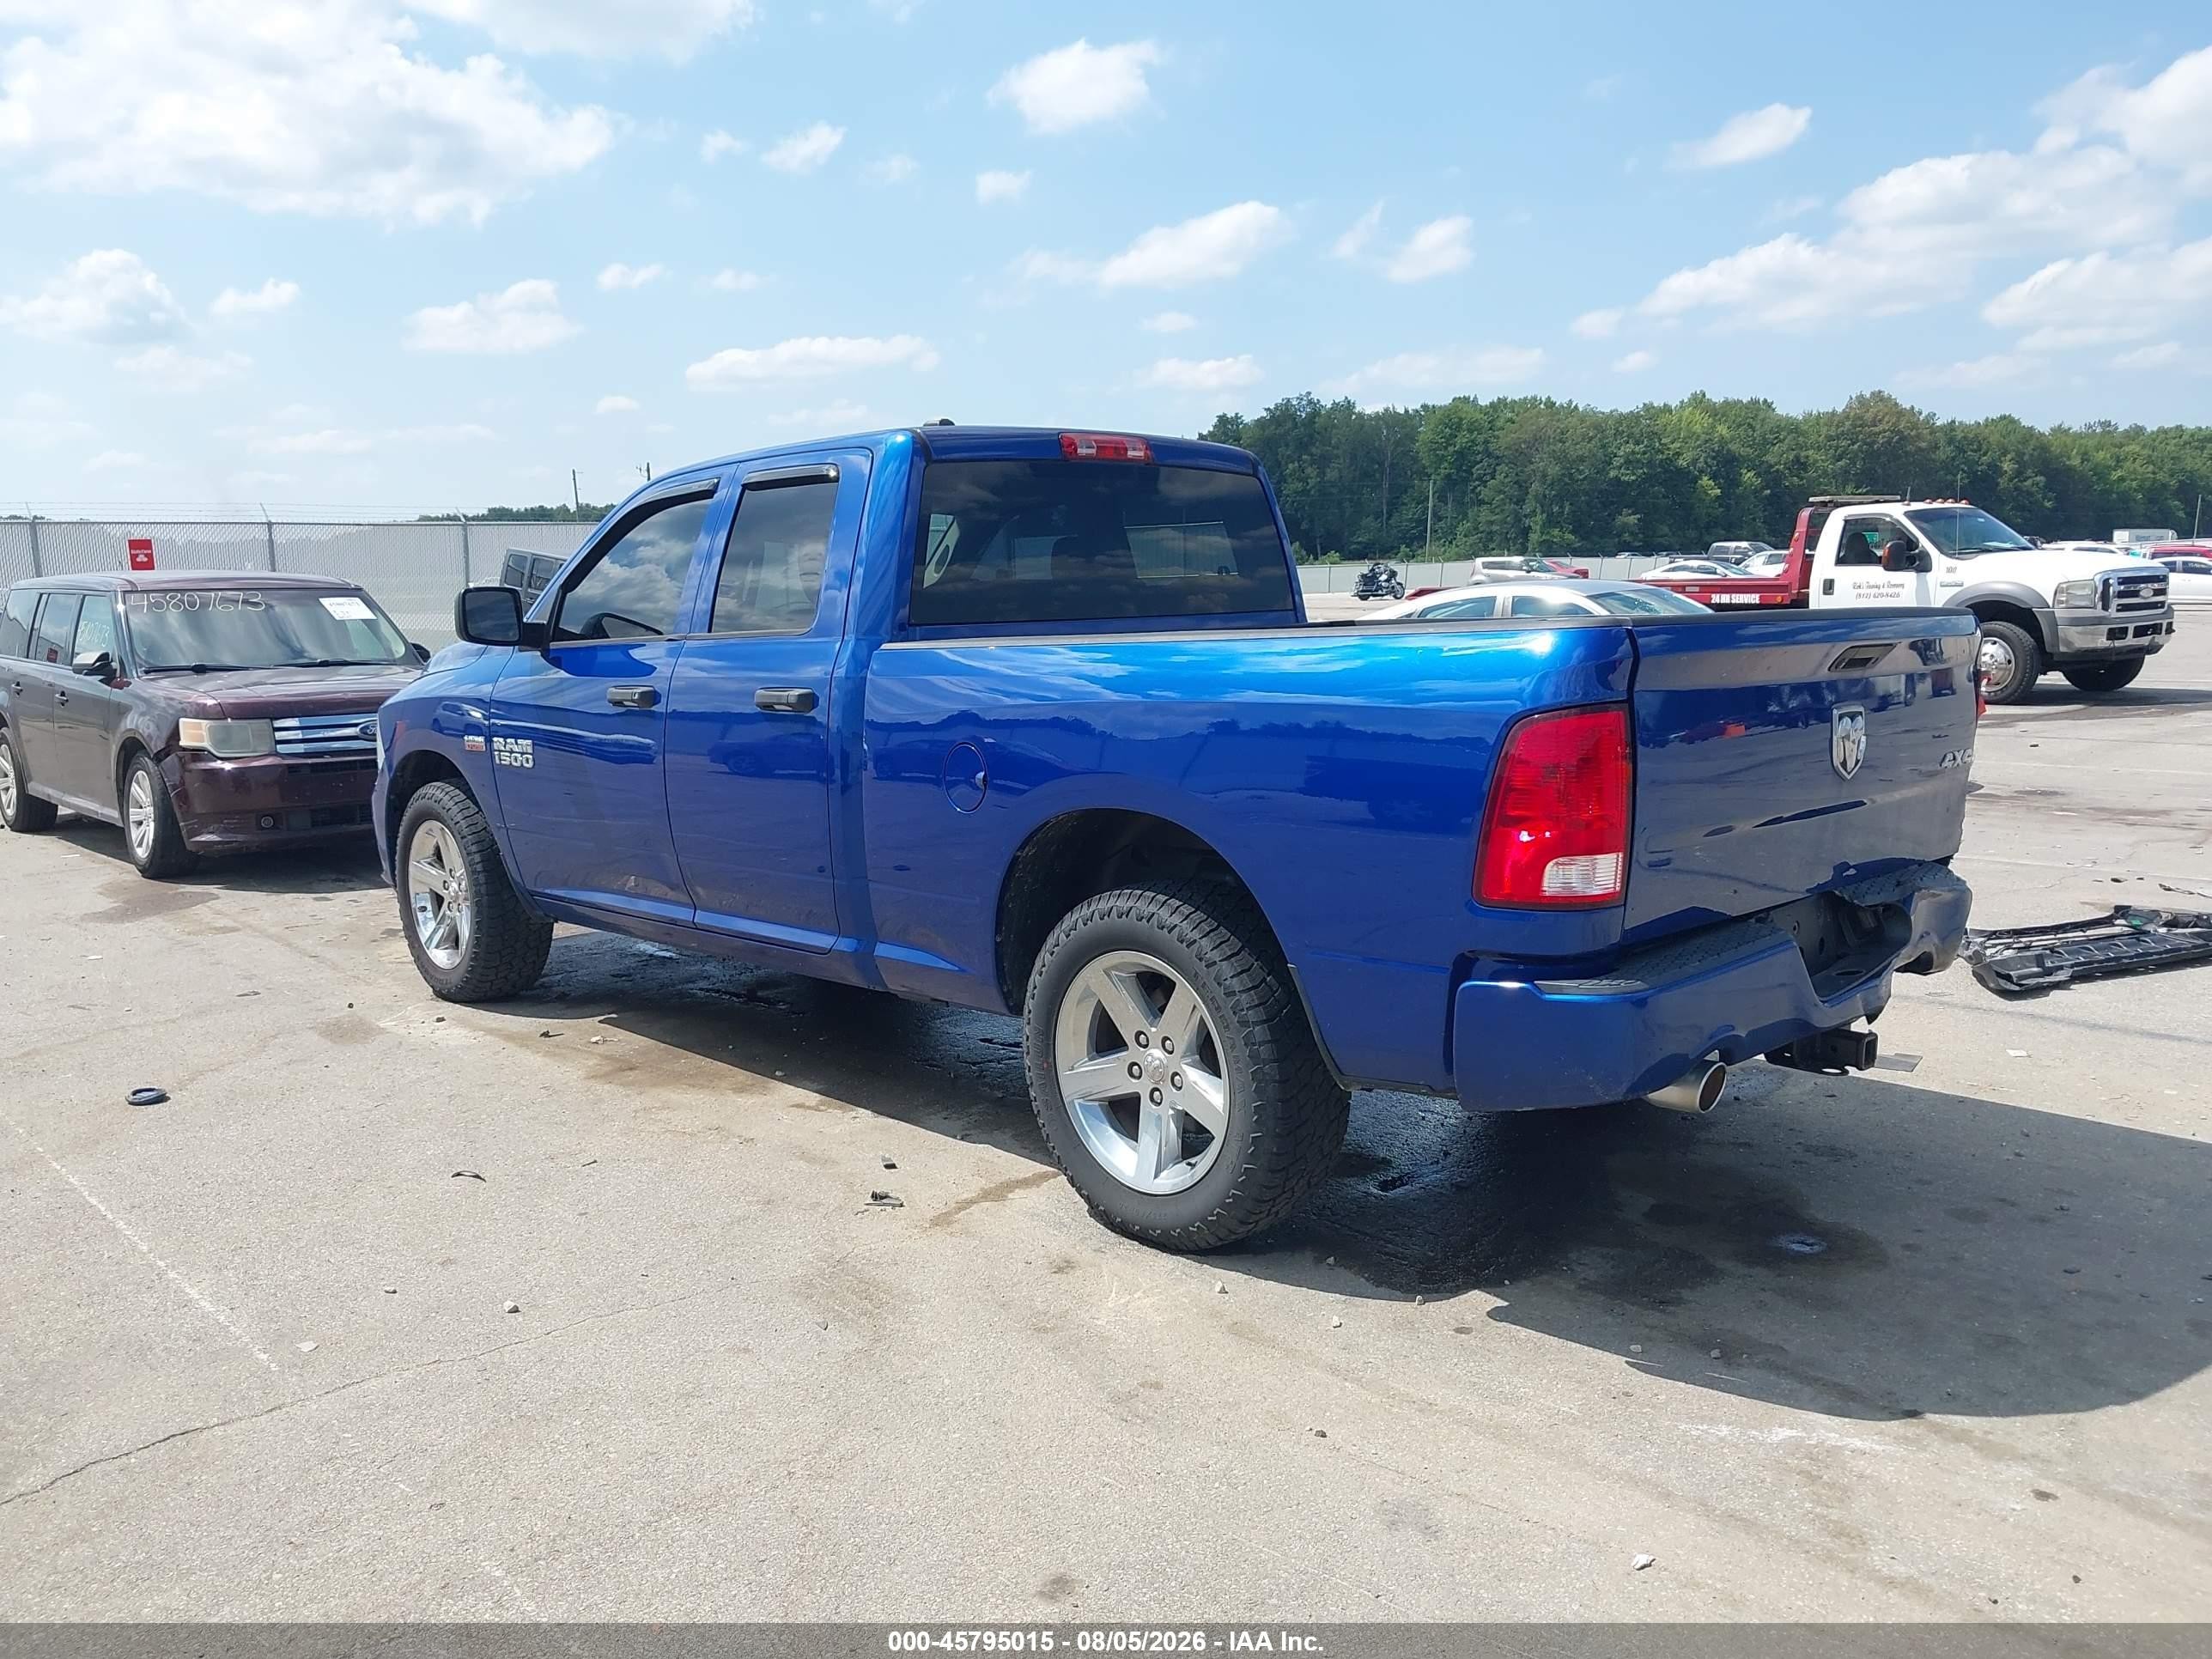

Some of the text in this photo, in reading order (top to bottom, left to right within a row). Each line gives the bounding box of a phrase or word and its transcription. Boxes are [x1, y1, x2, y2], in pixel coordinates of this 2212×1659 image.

[131, 591, 266, 614] 45807673
[1711, 592, 1760, 605] 24 HR SERVICE
[492, 737, 533, 754] RAM
[494, 750, 535, 769] 1500
